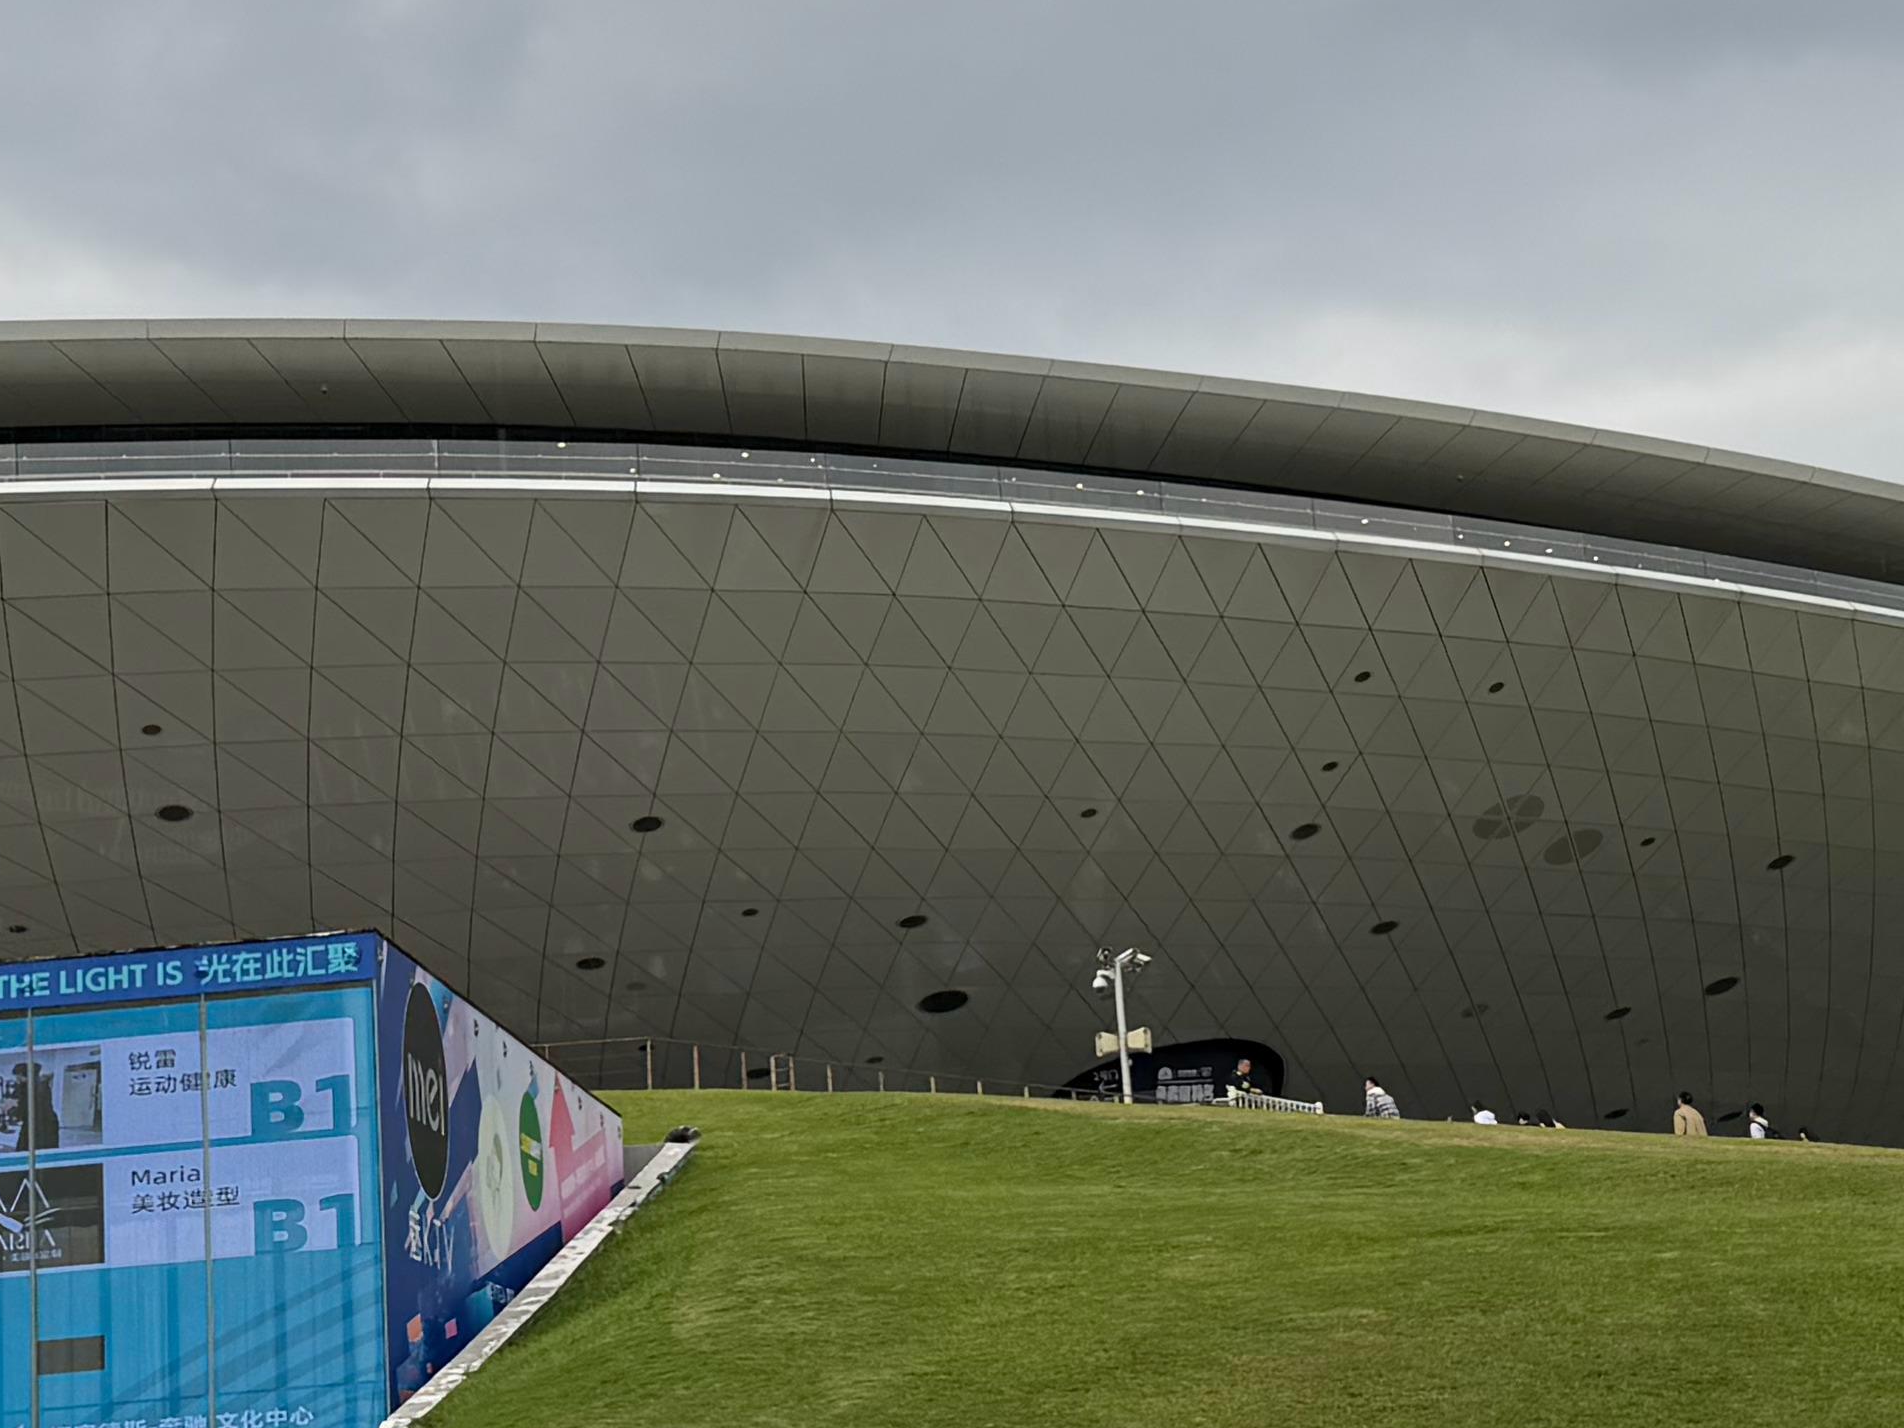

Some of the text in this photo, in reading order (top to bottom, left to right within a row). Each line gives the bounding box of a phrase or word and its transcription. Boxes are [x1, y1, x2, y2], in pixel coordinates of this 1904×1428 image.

[60, 963, 148, 994] LIGHT
[157, 960, 184, 987] IS
[196, 941, 359, 986] 光在此汇聚
[129, 1068, 238, 1097] 运动健康
[250, 1074, 351, 1137] B1
[131, 1165, 201, 1187] Maria
[131, 1185, 241, 1214] 美妆造型
[253, 1193, 356, 1256] B1
